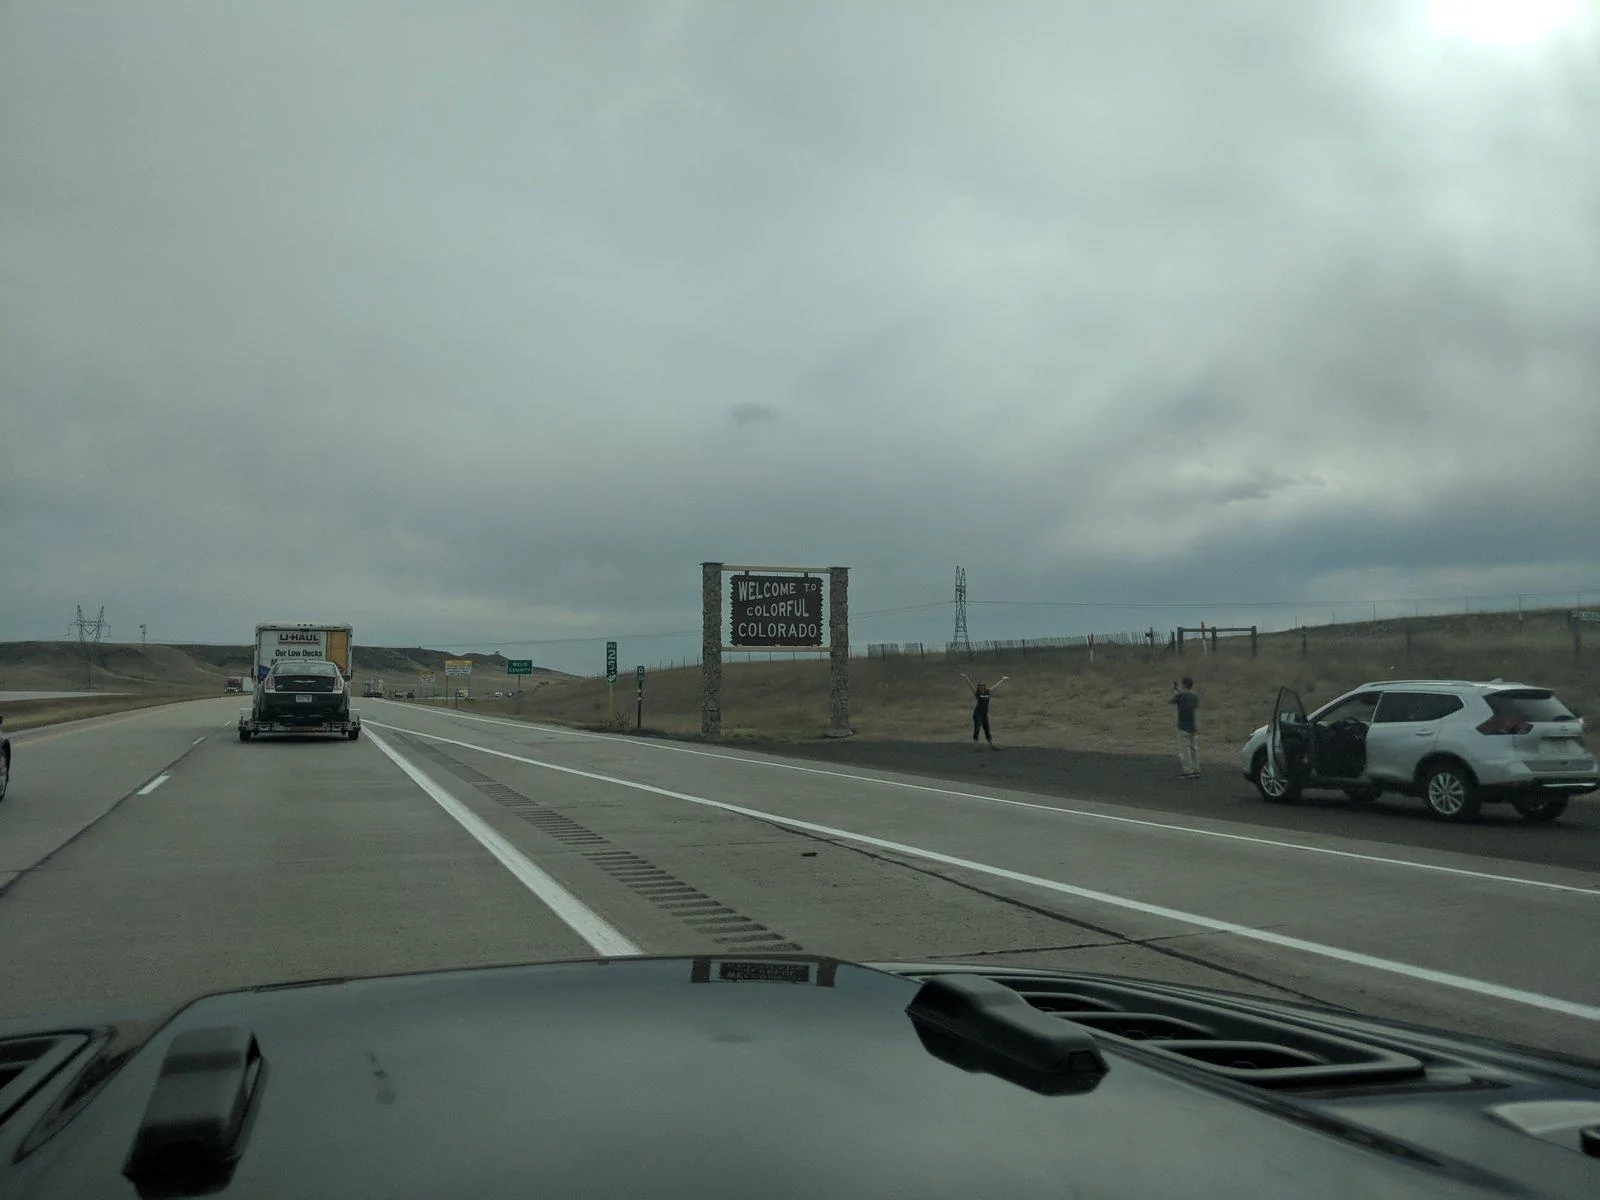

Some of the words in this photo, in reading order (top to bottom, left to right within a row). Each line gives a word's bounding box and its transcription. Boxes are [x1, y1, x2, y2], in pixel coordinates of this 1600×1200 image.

[738, 581, 796, 601] WELCOME
[803, 583, 816, 592] TO
[746, 599, 809, 617] COLORFUL
[738, 622, 817, 638] COLORADO
[275, 649, 287, 657] Our
[288, 649, 300, 657] Low
[302, 649, 322, 657] Decks
